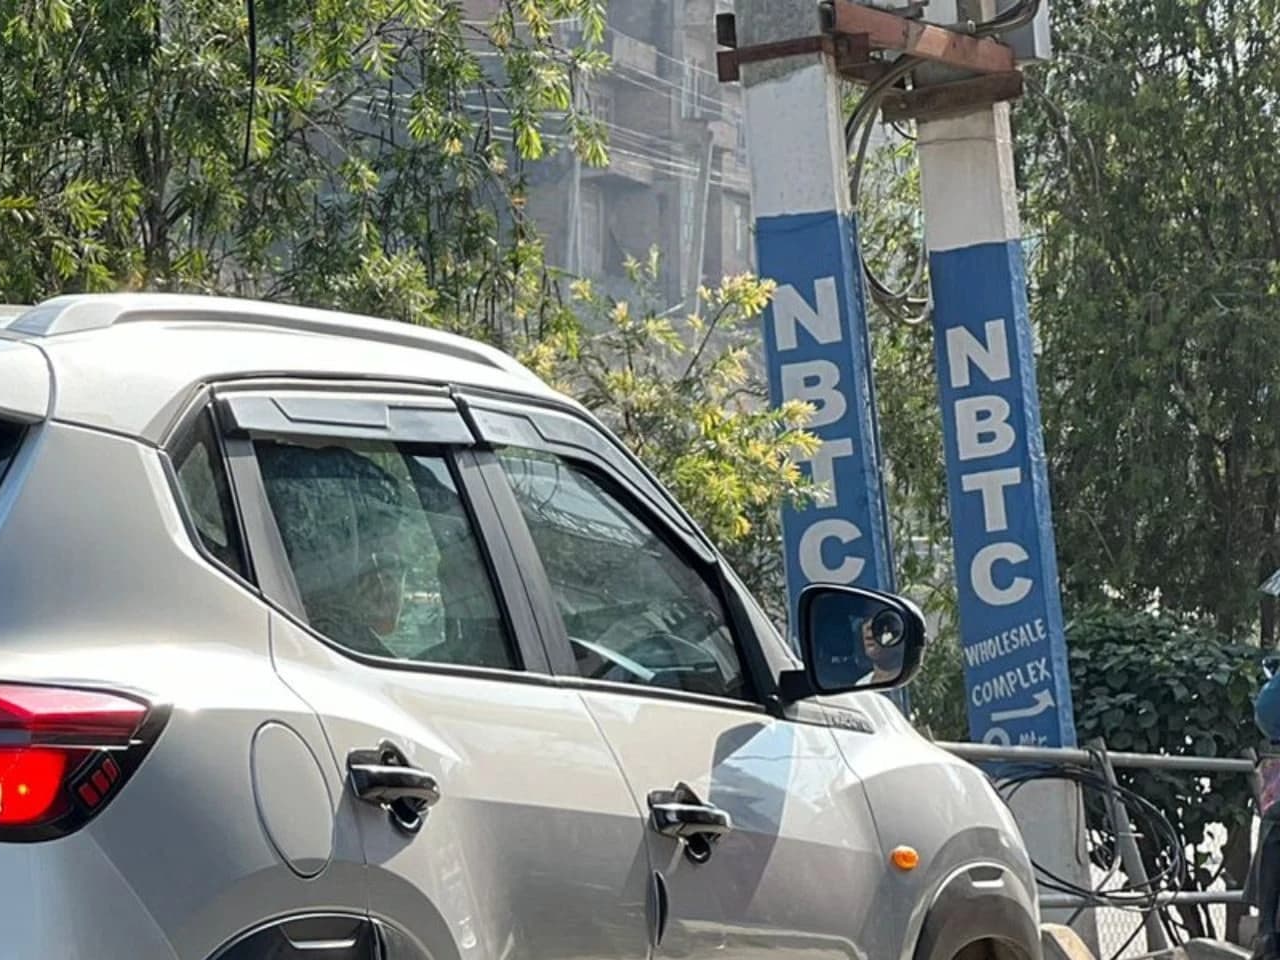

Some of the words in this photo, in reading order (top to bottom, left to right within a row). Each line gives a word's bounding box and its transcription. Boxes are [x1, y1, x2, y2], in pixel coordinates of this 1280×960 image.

[773, 278, 865, 585] NBTC
[946, 319, 1032, 606] NBTC
[964, 618, 1047, 667] WHOLESALE
[972, 657, 1052, 707] COMPLEX
